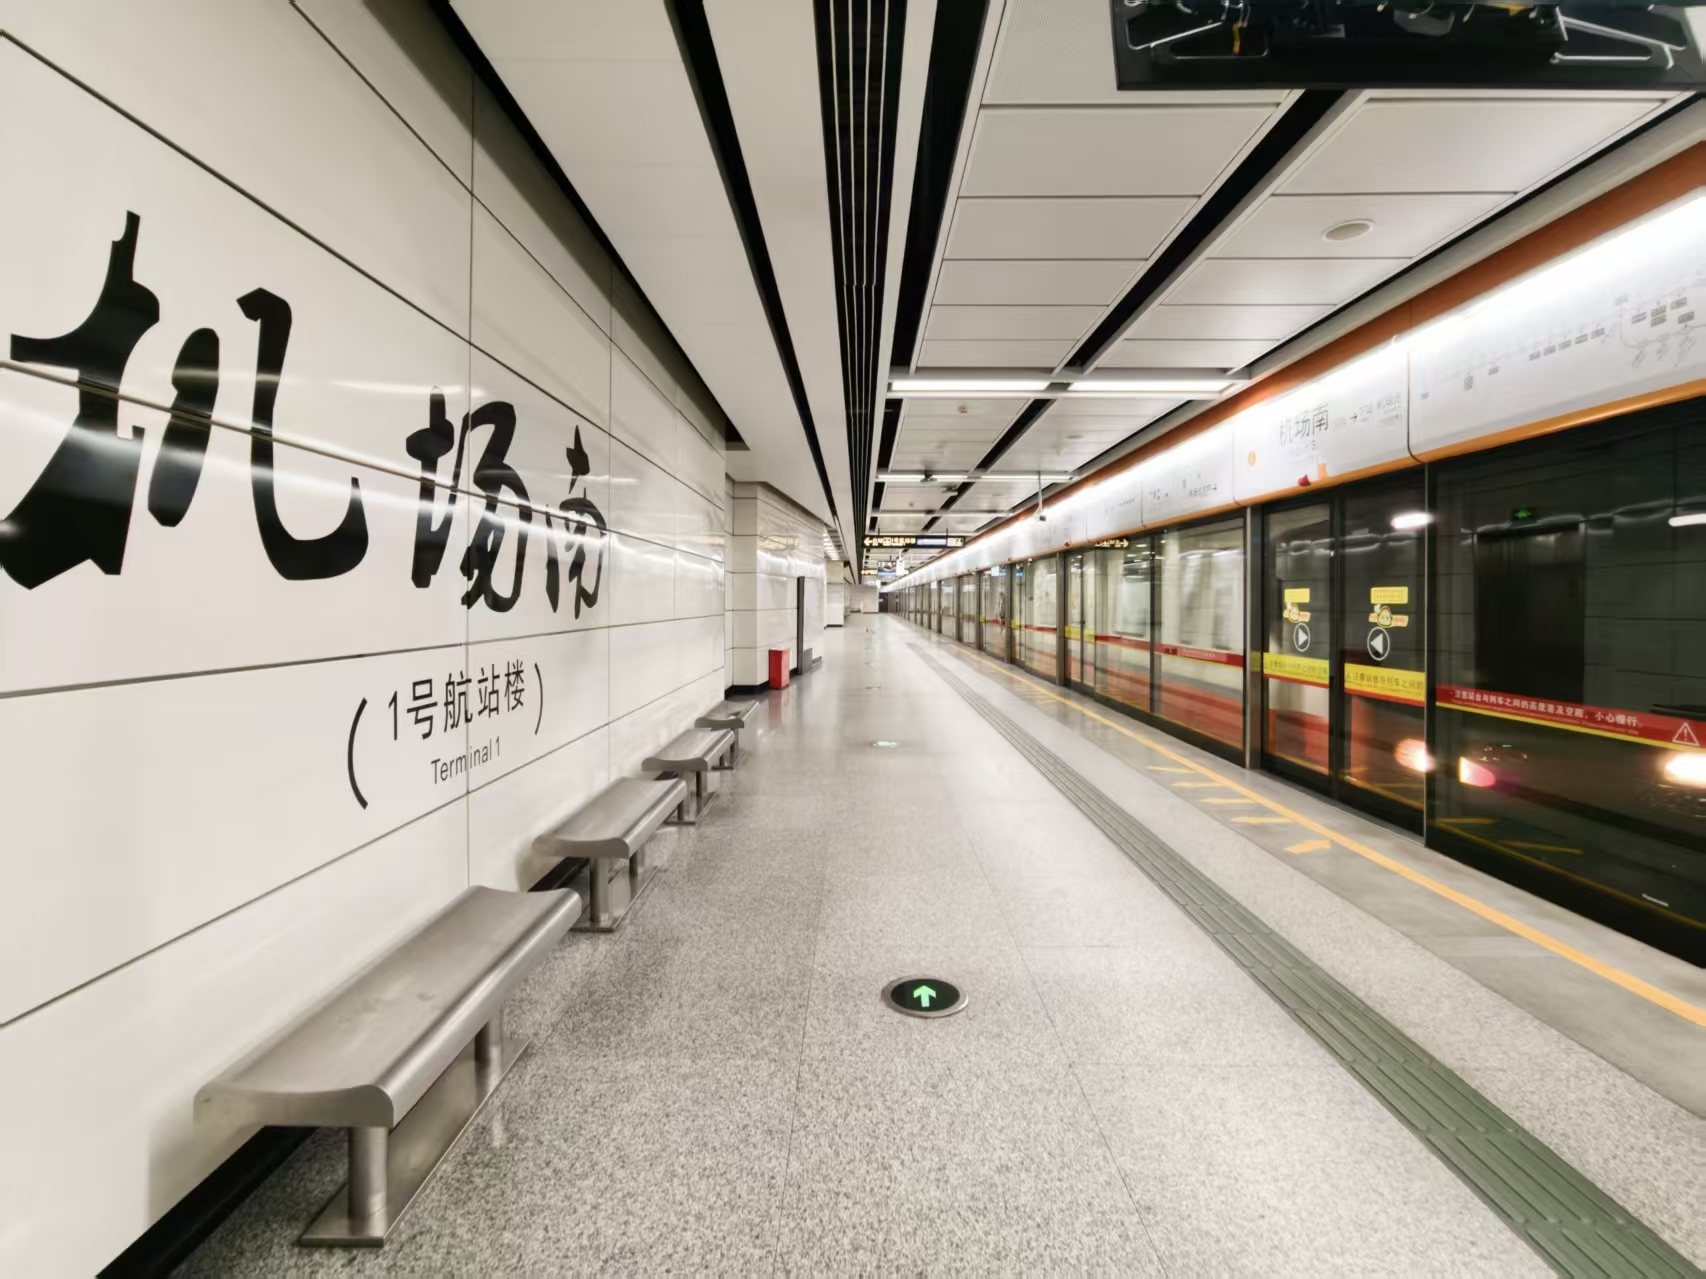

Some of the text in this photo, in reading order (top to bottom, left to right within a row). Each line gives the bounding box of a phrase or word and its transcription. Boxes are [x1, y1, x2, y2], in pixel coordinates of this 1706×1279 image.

[0, 210, 608, 620] 机场南
[1279, 403, 1329, 447] 机场南
[430, 737, 492, 785] Terminal
